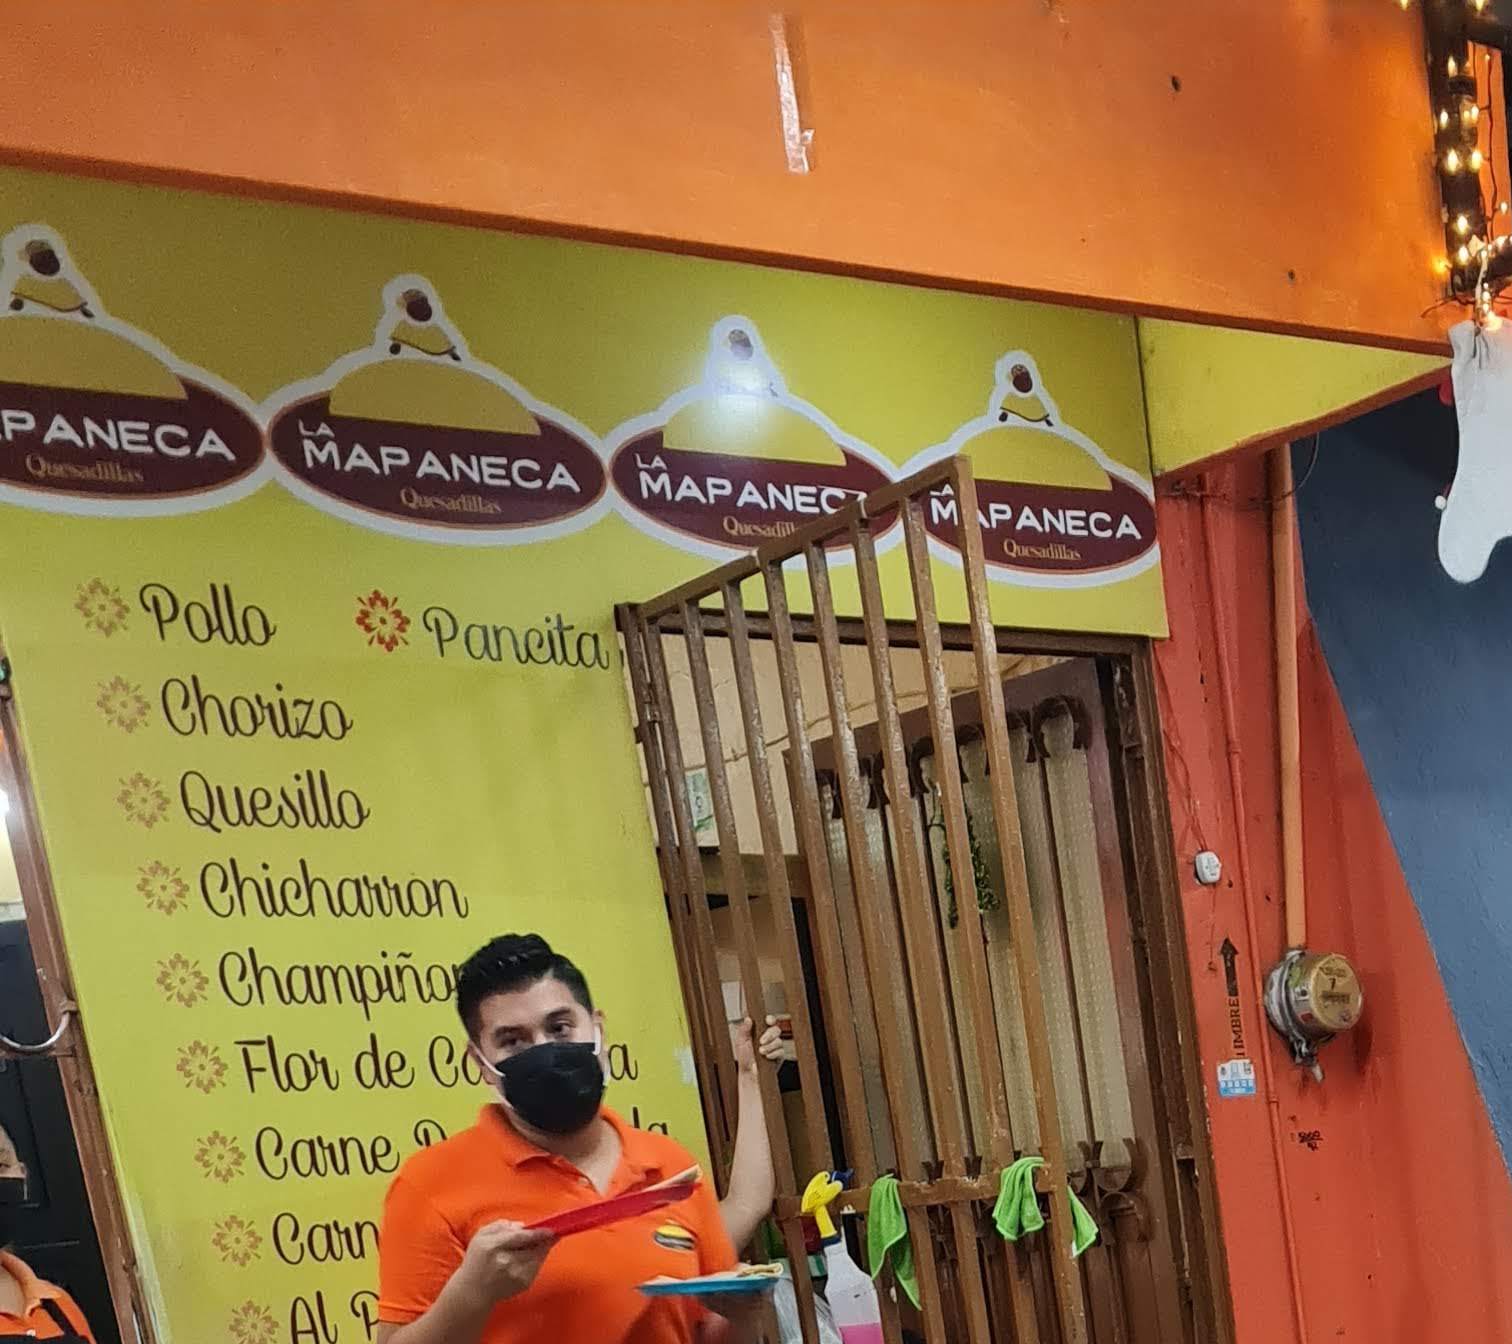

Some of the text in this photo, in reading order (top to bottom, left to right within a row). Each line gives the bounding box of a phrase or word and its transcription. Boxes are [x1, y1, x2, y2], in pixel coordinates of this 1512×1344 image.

[0, 409, 236, 461] PANECA
[297, 419, 335, 437] LA
[302, 438, 582, 494] MAPANECA
[634, 452, 668, 470] LA
[400, 487, 502, 514] Quesadillas
[639, 471, 866, 514] MAPANEC
[1003, 537, 1081, 561] Quesadillas
[139, 583, 277, 646] Pollo
[422, 606, 609, 670] Pancita
[161, 674, 354, 741] Chorizo
[180, 769, 371, 834] Quesillo
[200, 857, 469, 919] Chicharron
[218, 946, 459, 1022] Champiño
[234, 1034, 340, 1093] Flor
[354, 1032, 415, 1090] de
[255, 1126, 401, 1181] Carne
